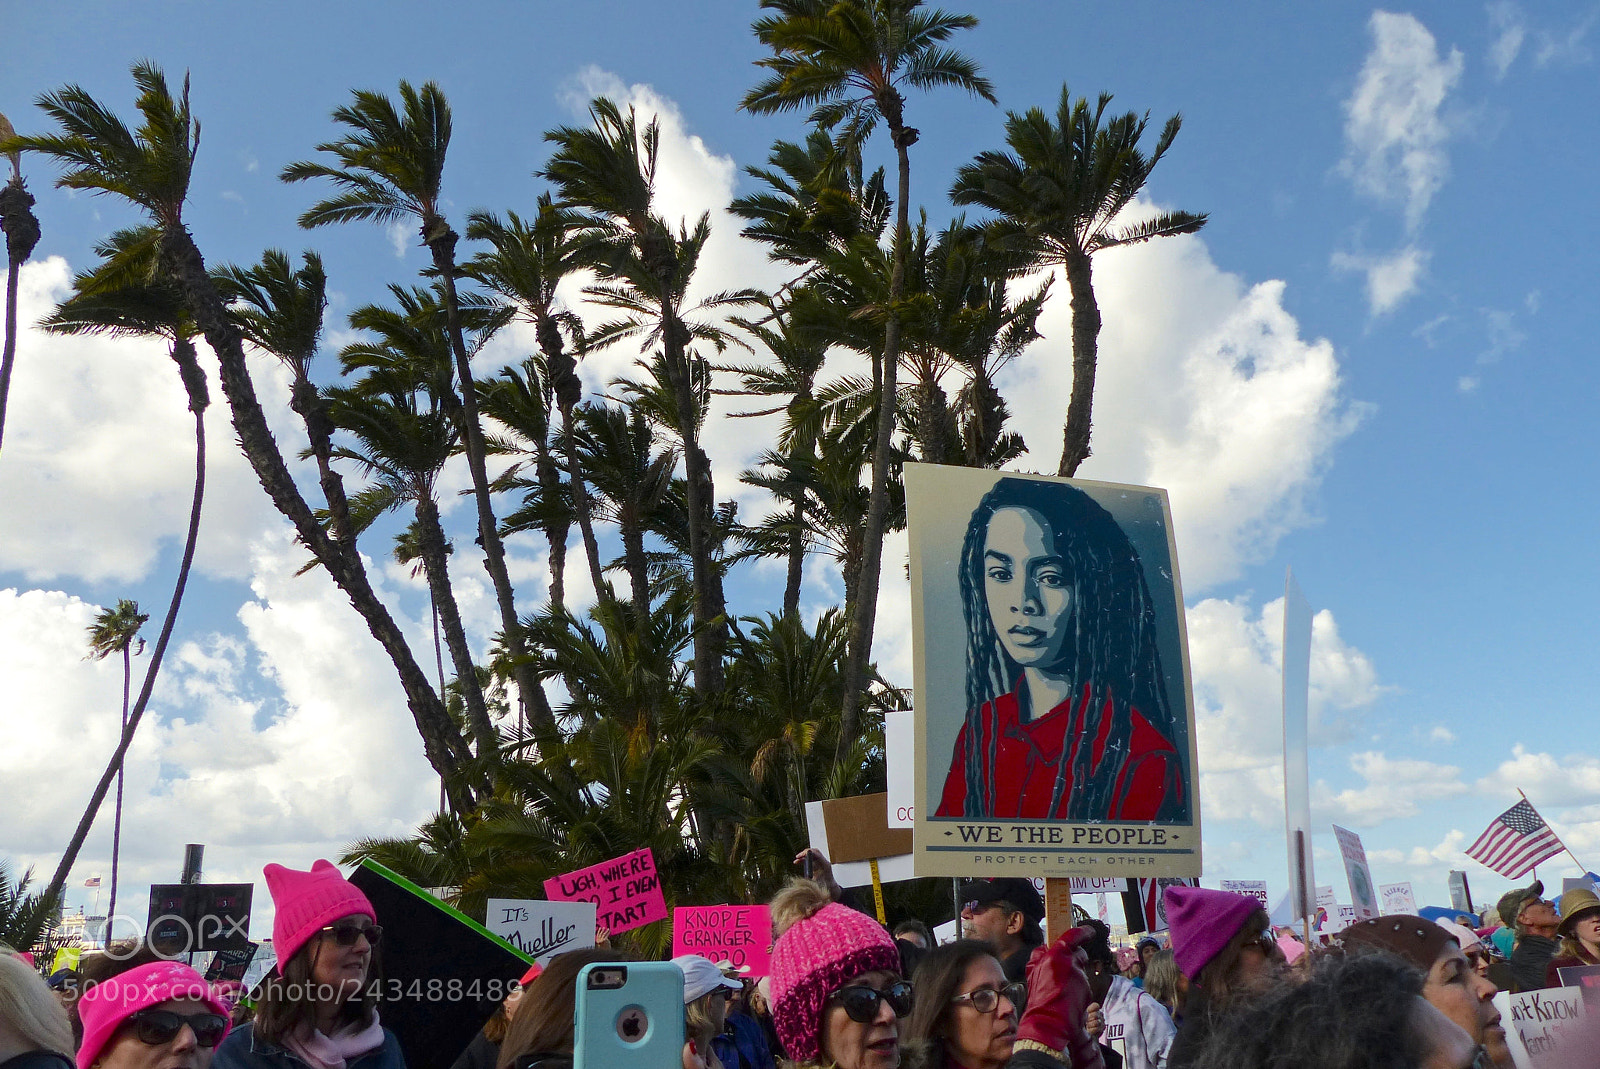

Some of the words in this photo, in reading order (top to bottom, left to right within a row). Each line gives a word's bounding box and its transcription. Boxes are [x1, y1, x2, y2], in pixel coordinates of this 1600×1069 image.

[957, 826, 1003, 843] WE
[1010, 827, 1064, 844] THE
[1071, 827, 1168, 845] PEOPLE
[974, 855, 1049, 864] PROTECT
[1057, 856, 1098, 865] EACH
[1106, 856, 1156, 865] OTHER
[561, 873, 600, 897] UGH,
[600, 854, 651, 882] WHERE
[608, 885, 622, 904] I
[626, 873, 659, 898] EVEN
[684, 909, 750, 929] KNOPE
[498, 916, 576, 956] Mueller
[682, 929, 757, 947] GRANGER
[1531, 993, 1578, 1022] Know
